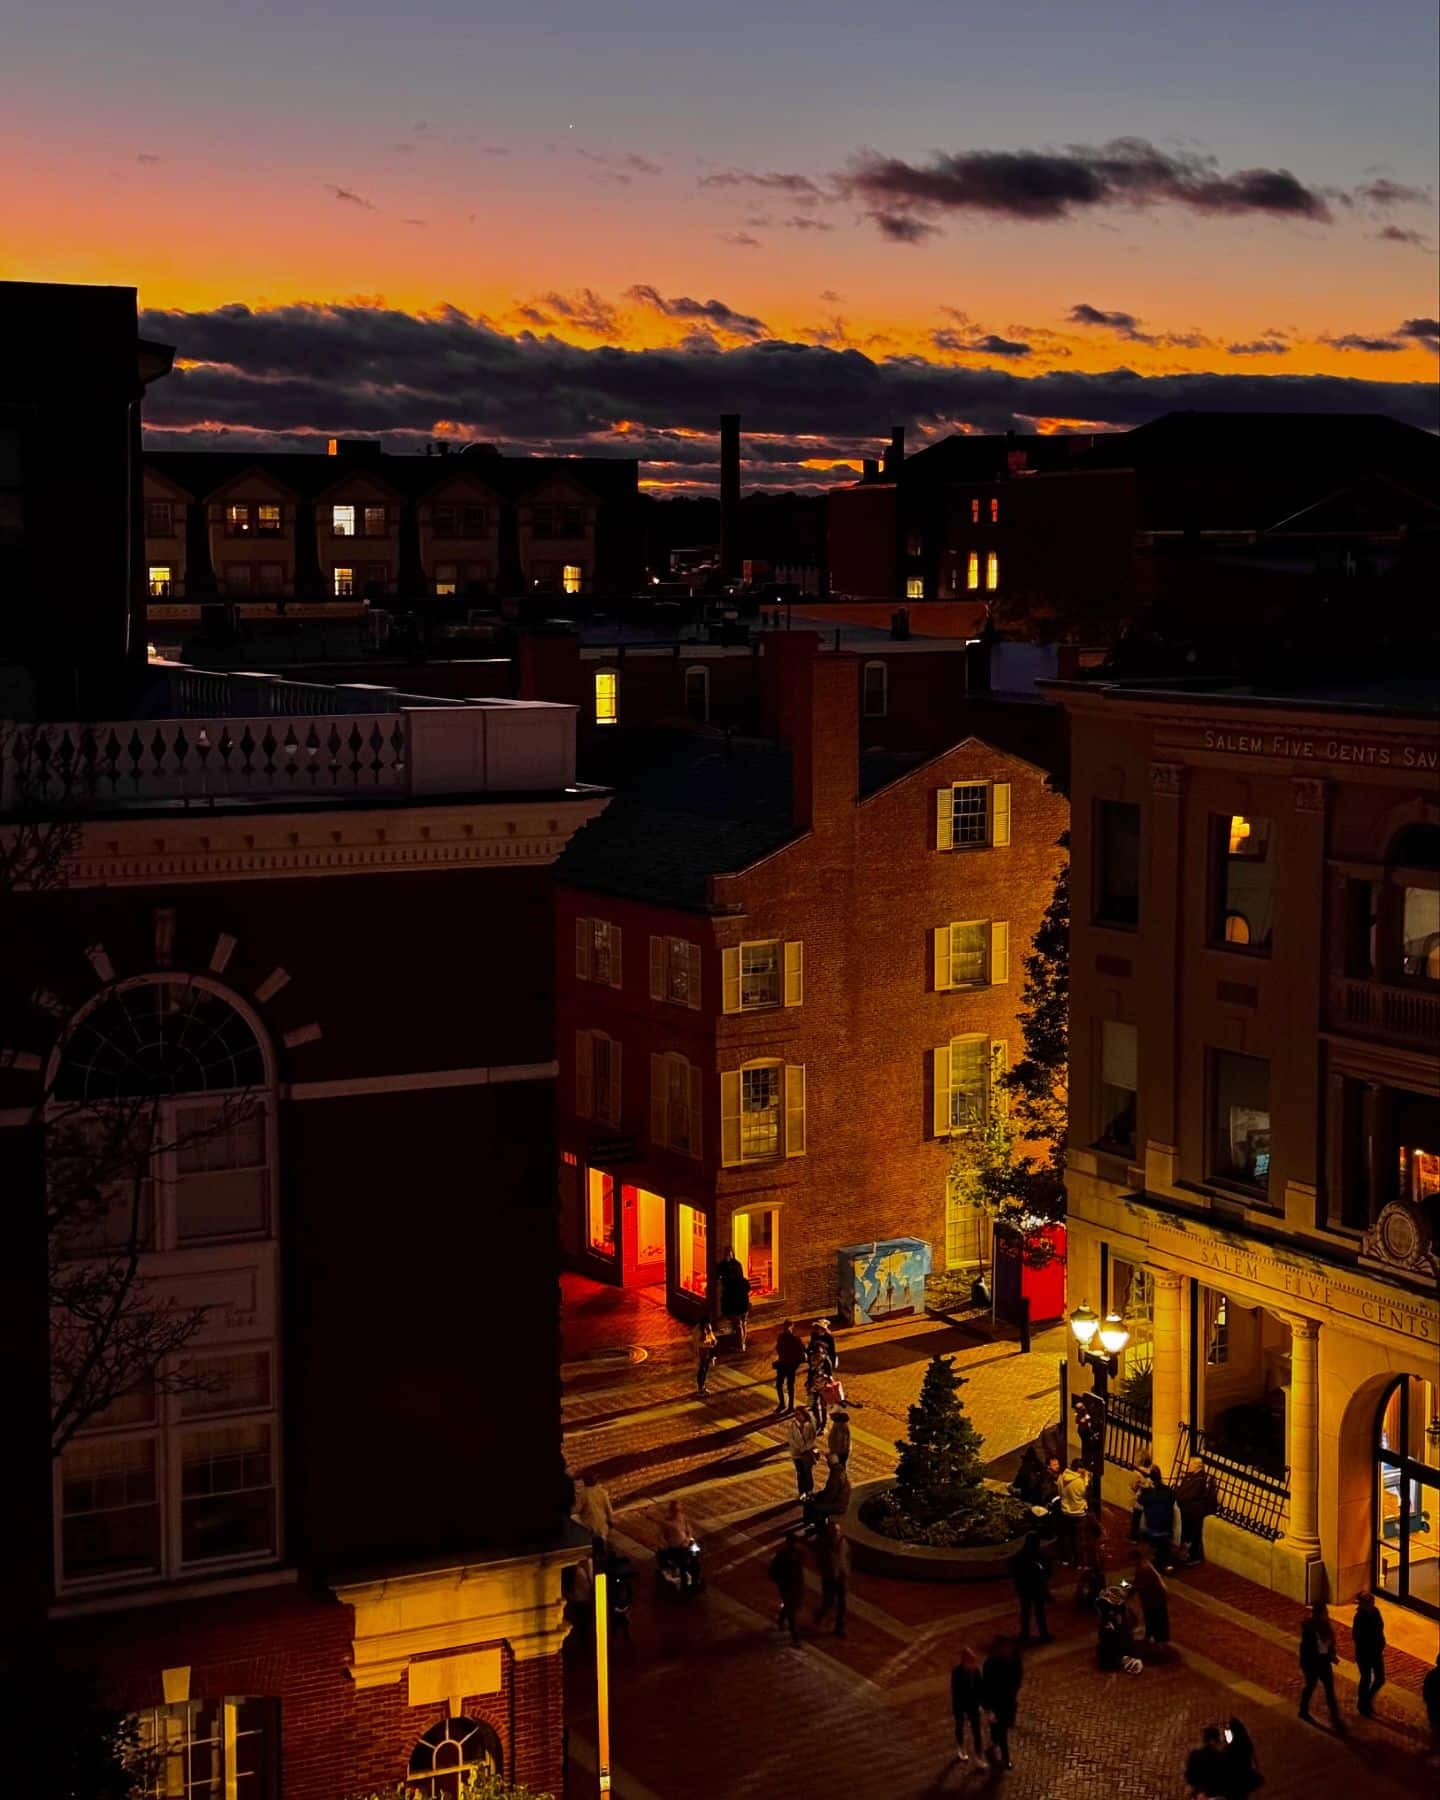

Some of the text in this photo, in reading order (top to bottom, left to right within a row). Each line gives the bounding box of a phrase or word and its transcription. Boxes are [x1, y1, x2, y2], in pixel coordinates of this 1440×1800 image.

[1204, 730, 1264, 753] SALEM
[1272, 736, 1314, 758] FIVE
[1327, 741, 1391, 765] CENTS
[1201, 1248, 1430, 1338] SALEM FIVE CENTS
